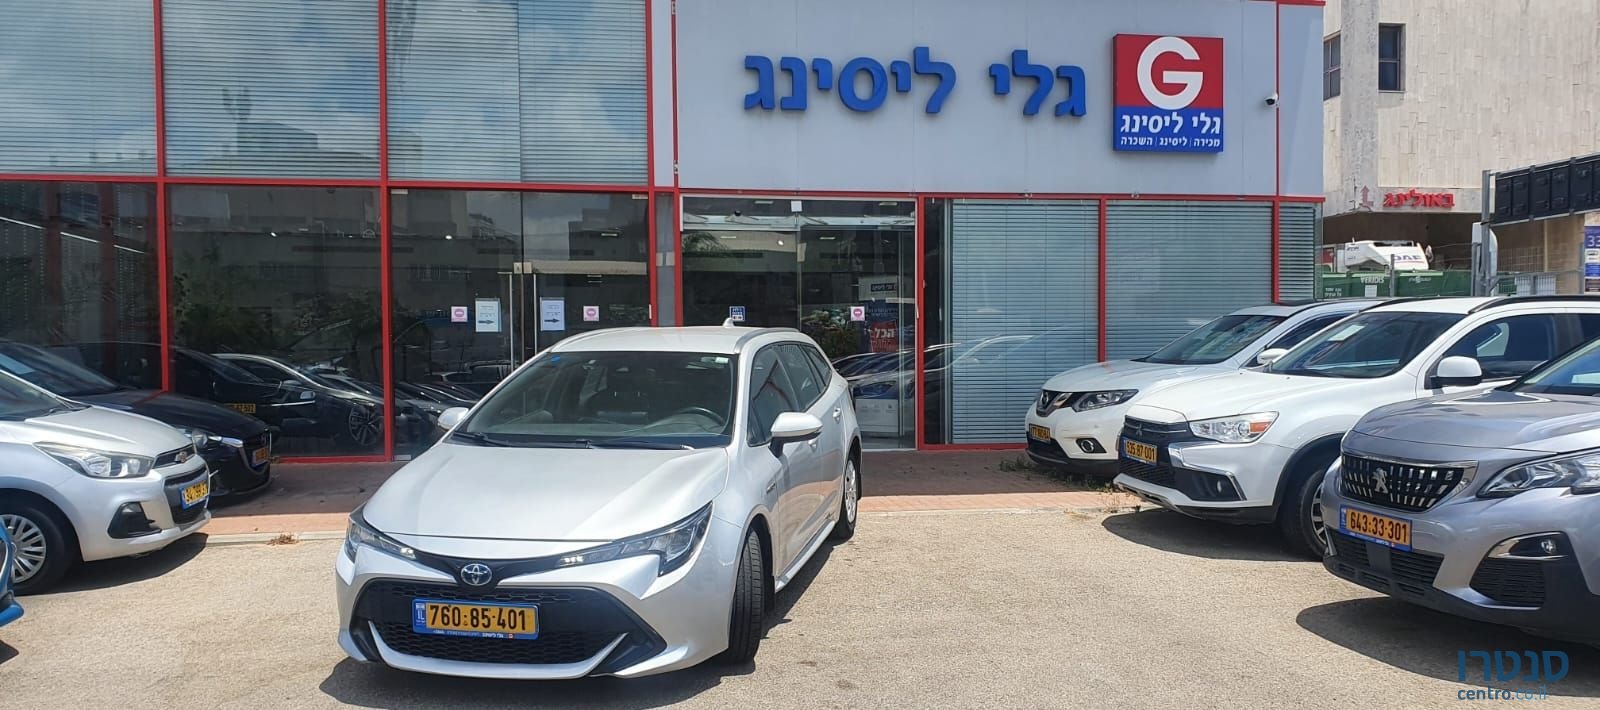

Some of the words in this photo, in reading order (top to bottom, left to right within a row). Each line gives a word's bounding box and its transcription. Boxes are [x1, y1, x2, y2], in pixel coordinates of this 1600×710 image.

[744, 46, 956, 115] ליסינג
[989, 49, 1086, 117] גלי
[1137, 36, 1203, 110] G
[1120, 111, 1184, 134] ליסינג
[1191, 112, 1221, 134] גלי
[1120, 136, 1153, 146] השכרה
[1159, 136, 1188, 147] ליסינג
[1193, 137, 1220, 147] מכירה
[1383, 188, 1455, 207] באולינג
